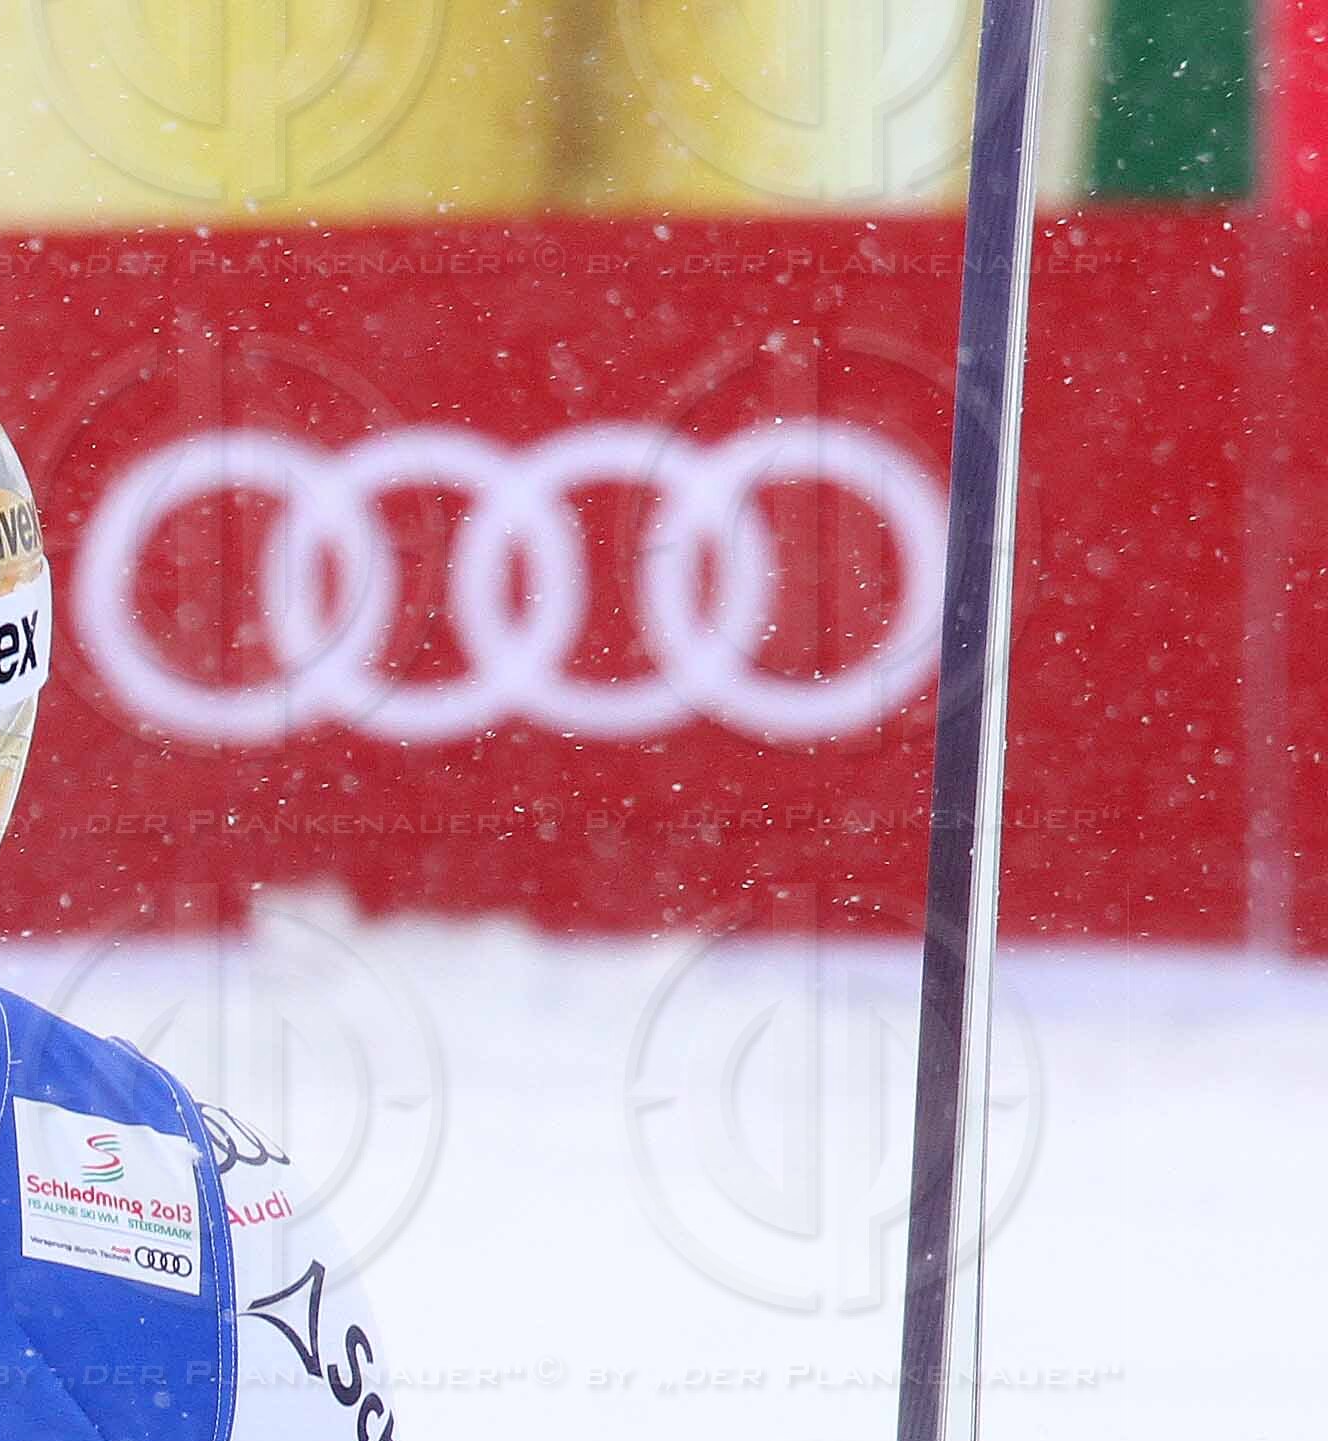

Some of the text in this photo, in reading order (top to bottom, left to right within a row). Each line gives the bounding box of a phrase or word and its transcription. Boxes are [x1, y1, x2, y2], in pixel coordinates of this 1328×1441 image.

[26, 1174, 193, 1225] Schladming 2013
[225, 1190, 293, 1228] Audi
